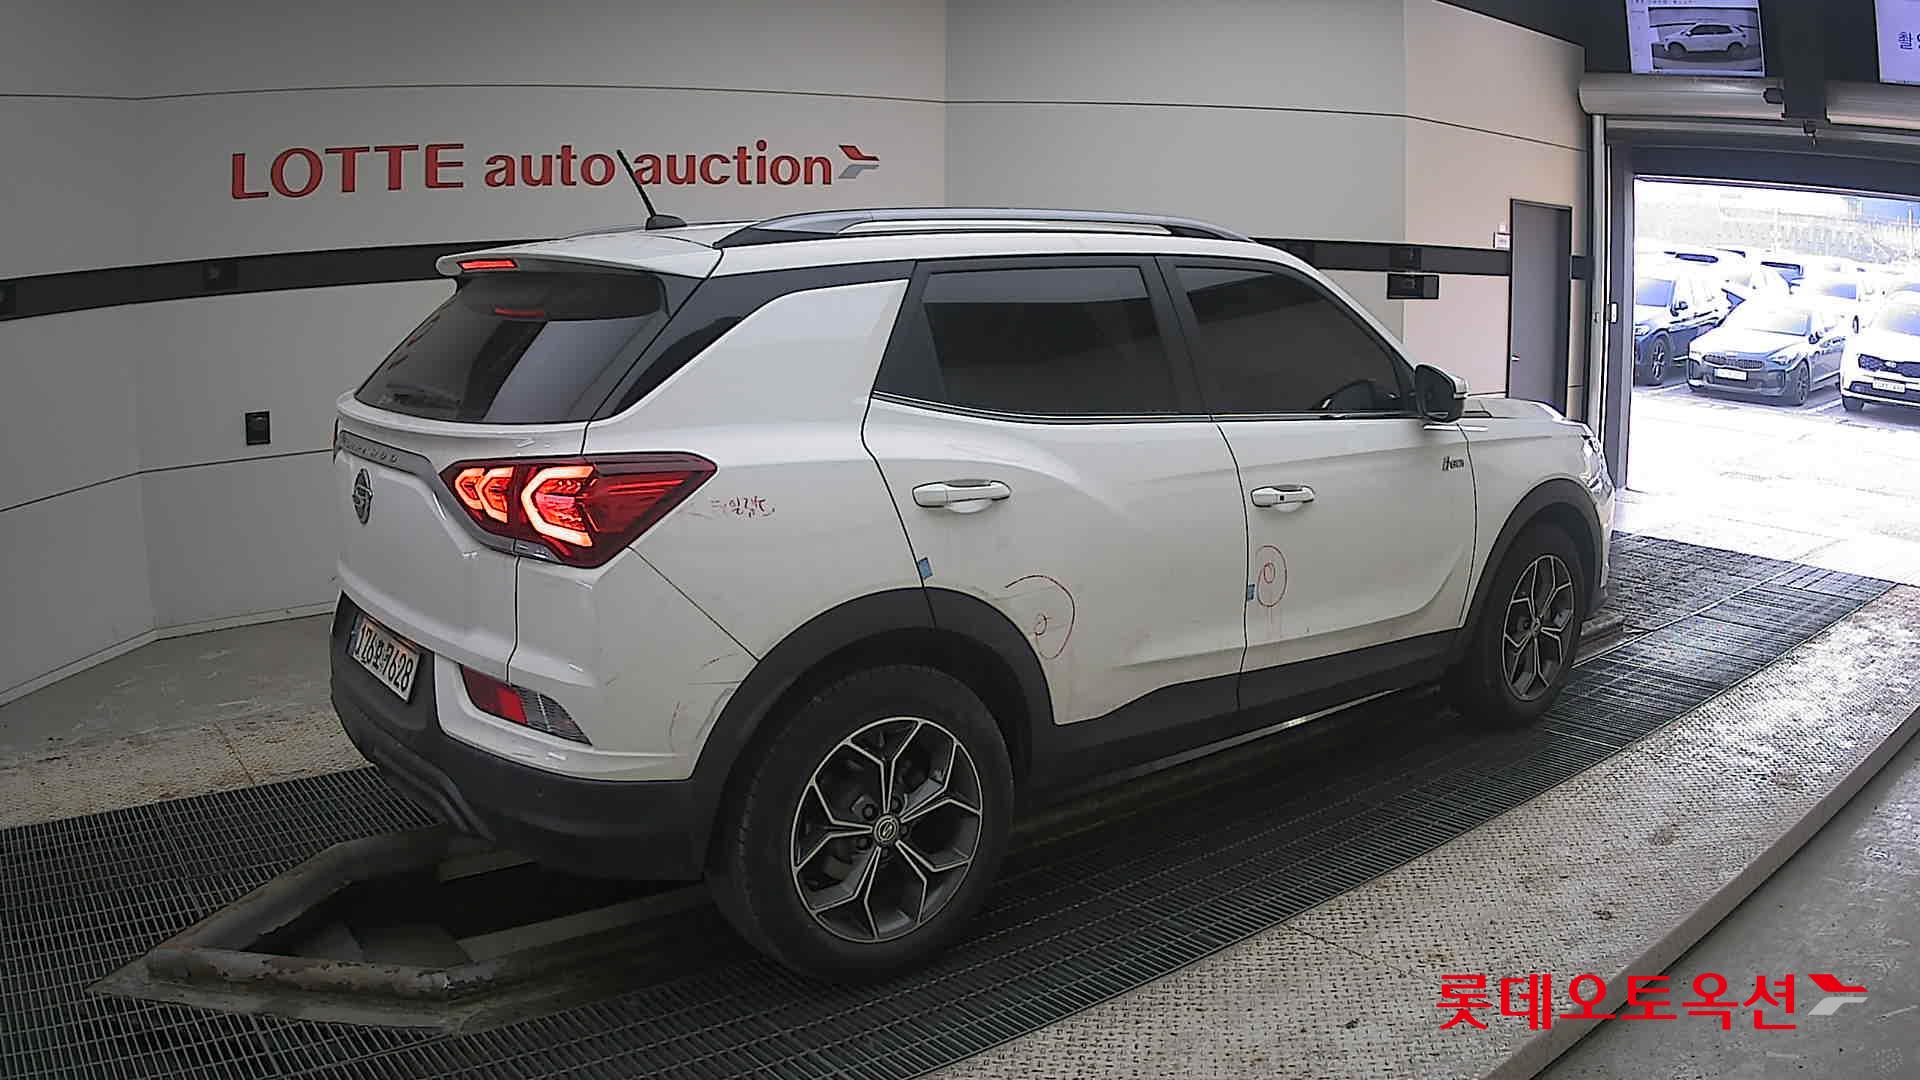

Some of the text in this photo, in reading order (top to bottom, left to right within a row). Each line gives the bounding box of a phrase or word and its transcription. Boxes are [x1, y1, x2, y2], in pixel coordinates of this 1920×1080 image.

[231, 140, 832, 200] LOTTE auto auction
